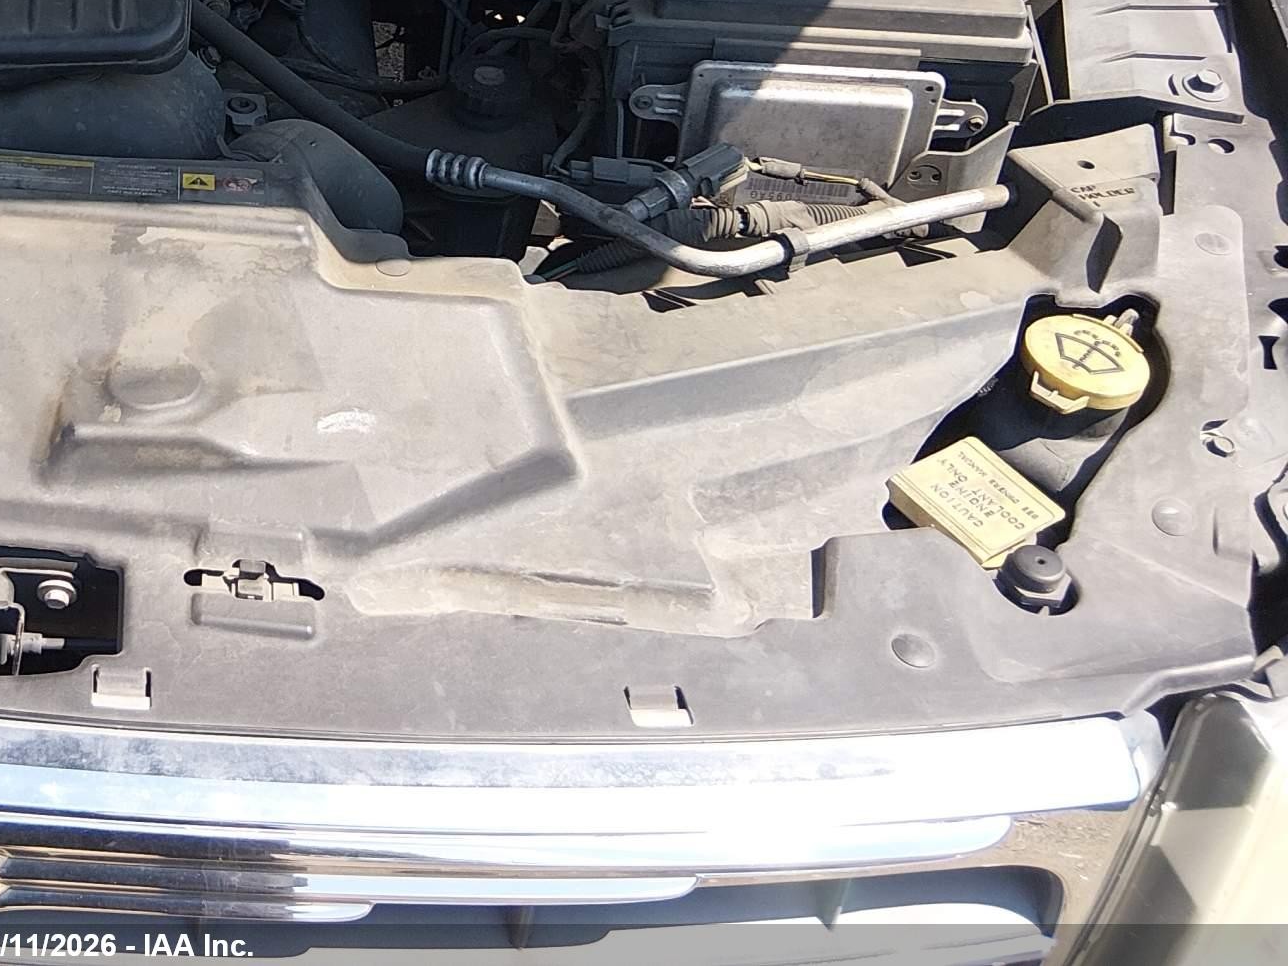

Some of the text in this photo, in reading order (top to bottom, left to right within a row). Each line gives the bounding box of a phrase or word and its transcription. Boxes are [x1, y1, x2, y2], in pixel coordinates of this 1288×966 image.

[1070, 184, 1096, 194] CAP
[1078, 187, 1135, 200] HOLDER
[931, 483, 984, 528] CAUTION
[936, 458, 1025, 530] COOLANT ONLY
[948, 477, 995, 518] ENGINE
